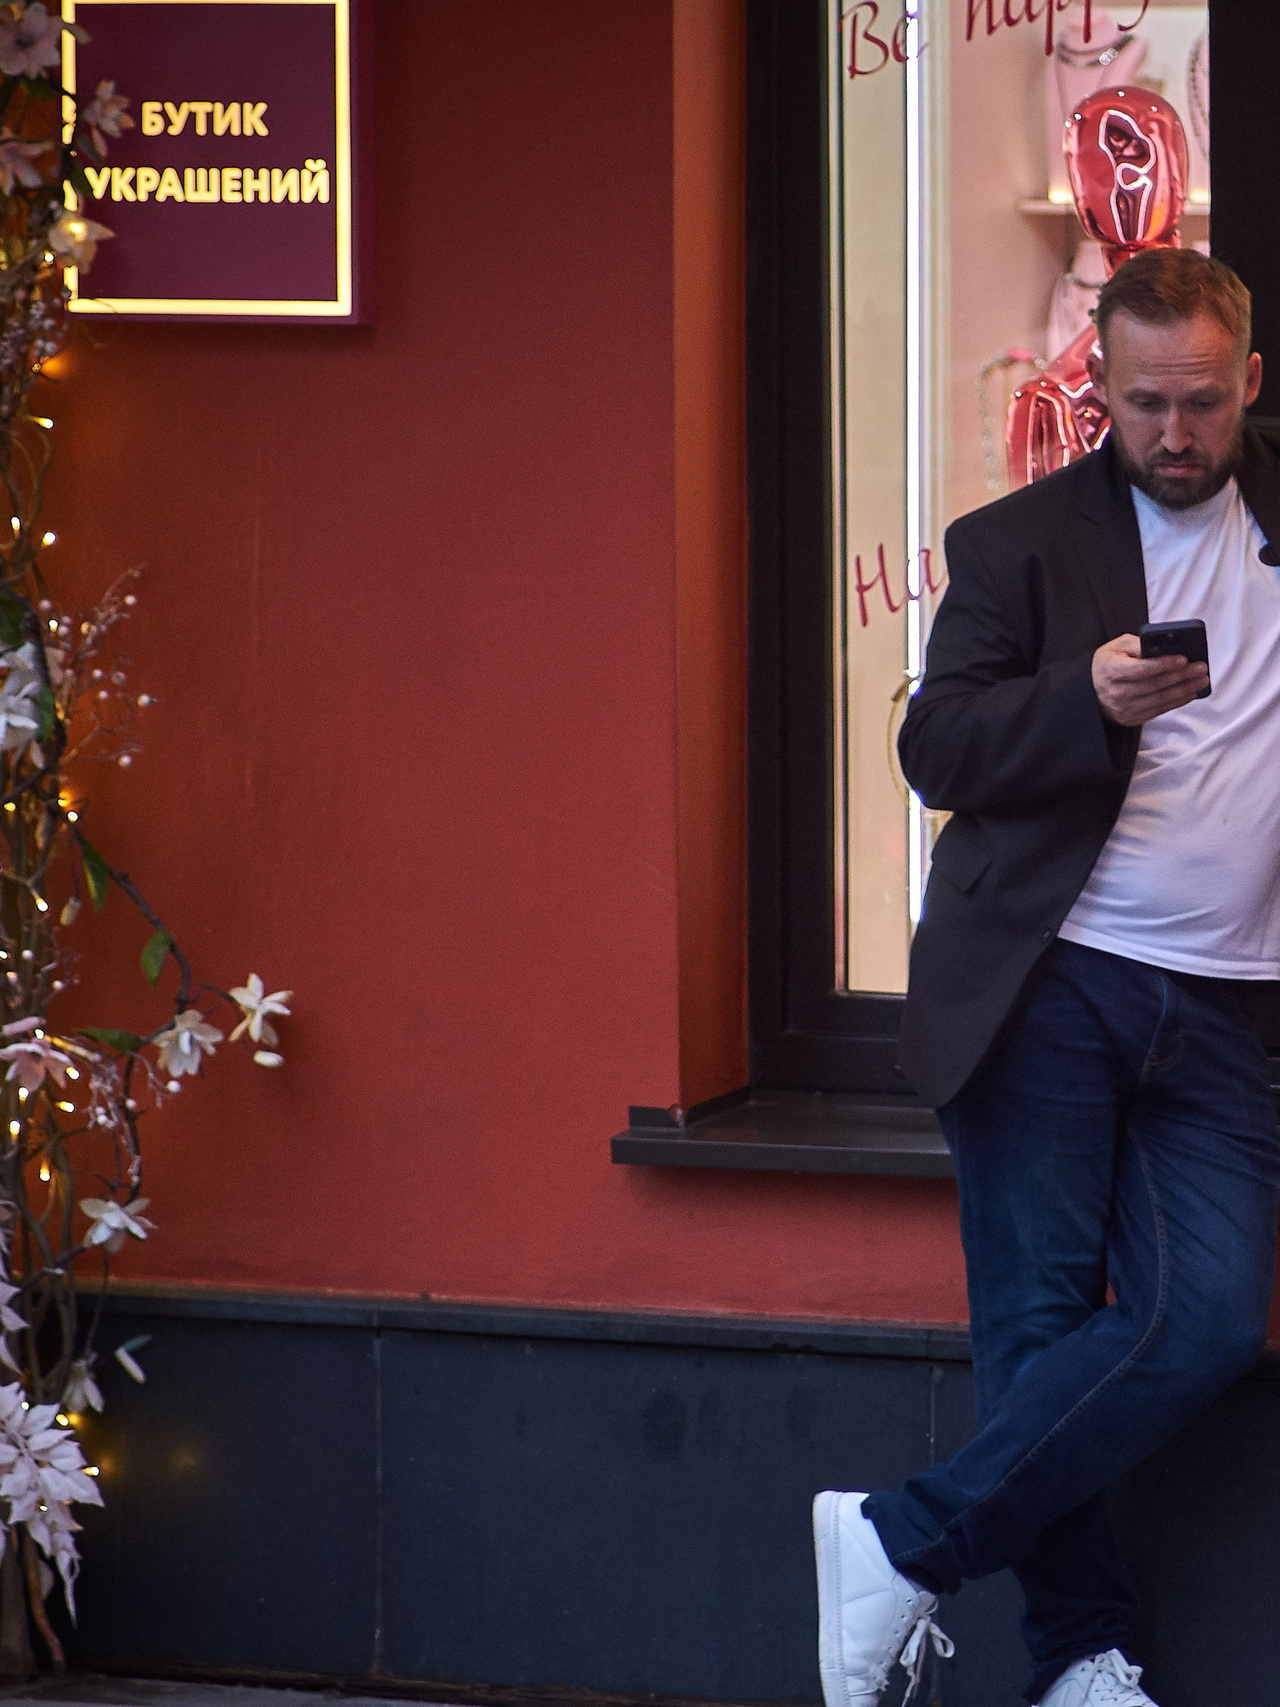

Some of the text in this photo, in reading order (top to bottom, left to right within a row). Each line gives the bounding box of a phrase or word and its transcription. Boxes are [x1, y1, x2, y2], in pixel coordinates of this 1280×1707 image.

[837, 0, 931, 80] Be
[142, 102, 269, 136] БУТИК
[84, 159, 330, 204] УКРАШЕНИЙ
[855, 542, 949, 628] Ha
